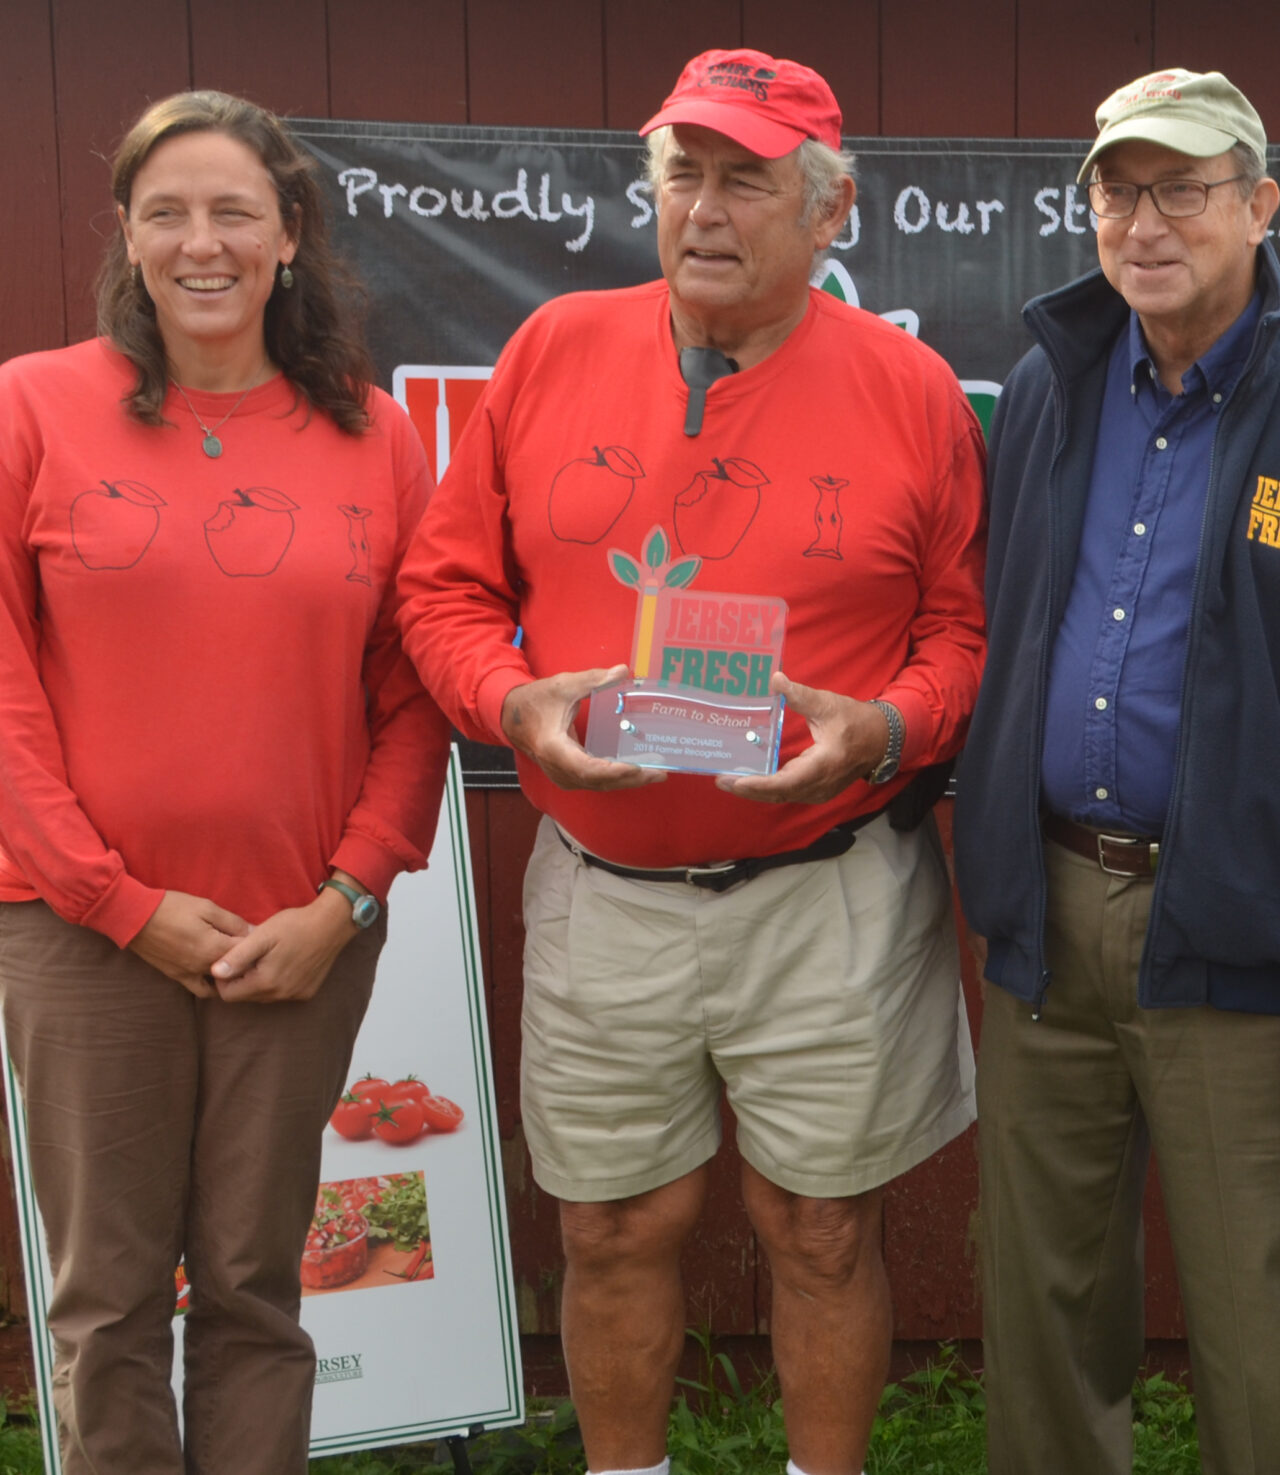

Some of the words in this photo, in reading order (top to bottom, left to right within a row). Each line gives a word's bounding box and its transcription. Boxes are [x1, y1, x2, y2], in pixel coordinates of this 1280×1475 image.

[338, 167, 594, 253] Proudly
[893, 185, 1004, 235] Our
[664, 597, 780, 645] JERSEY
[657, 647, 773, 698] FRESH
[651, 702, 687, 718] Farm
[691, 711, 704, 721] to
[707, 713, 752, 729] School
[645, 733, 677, 744] TERHUNE
[679, 736, 724, 748] ORCHARDS
[317, 1353, 362, 1373] RSEY
